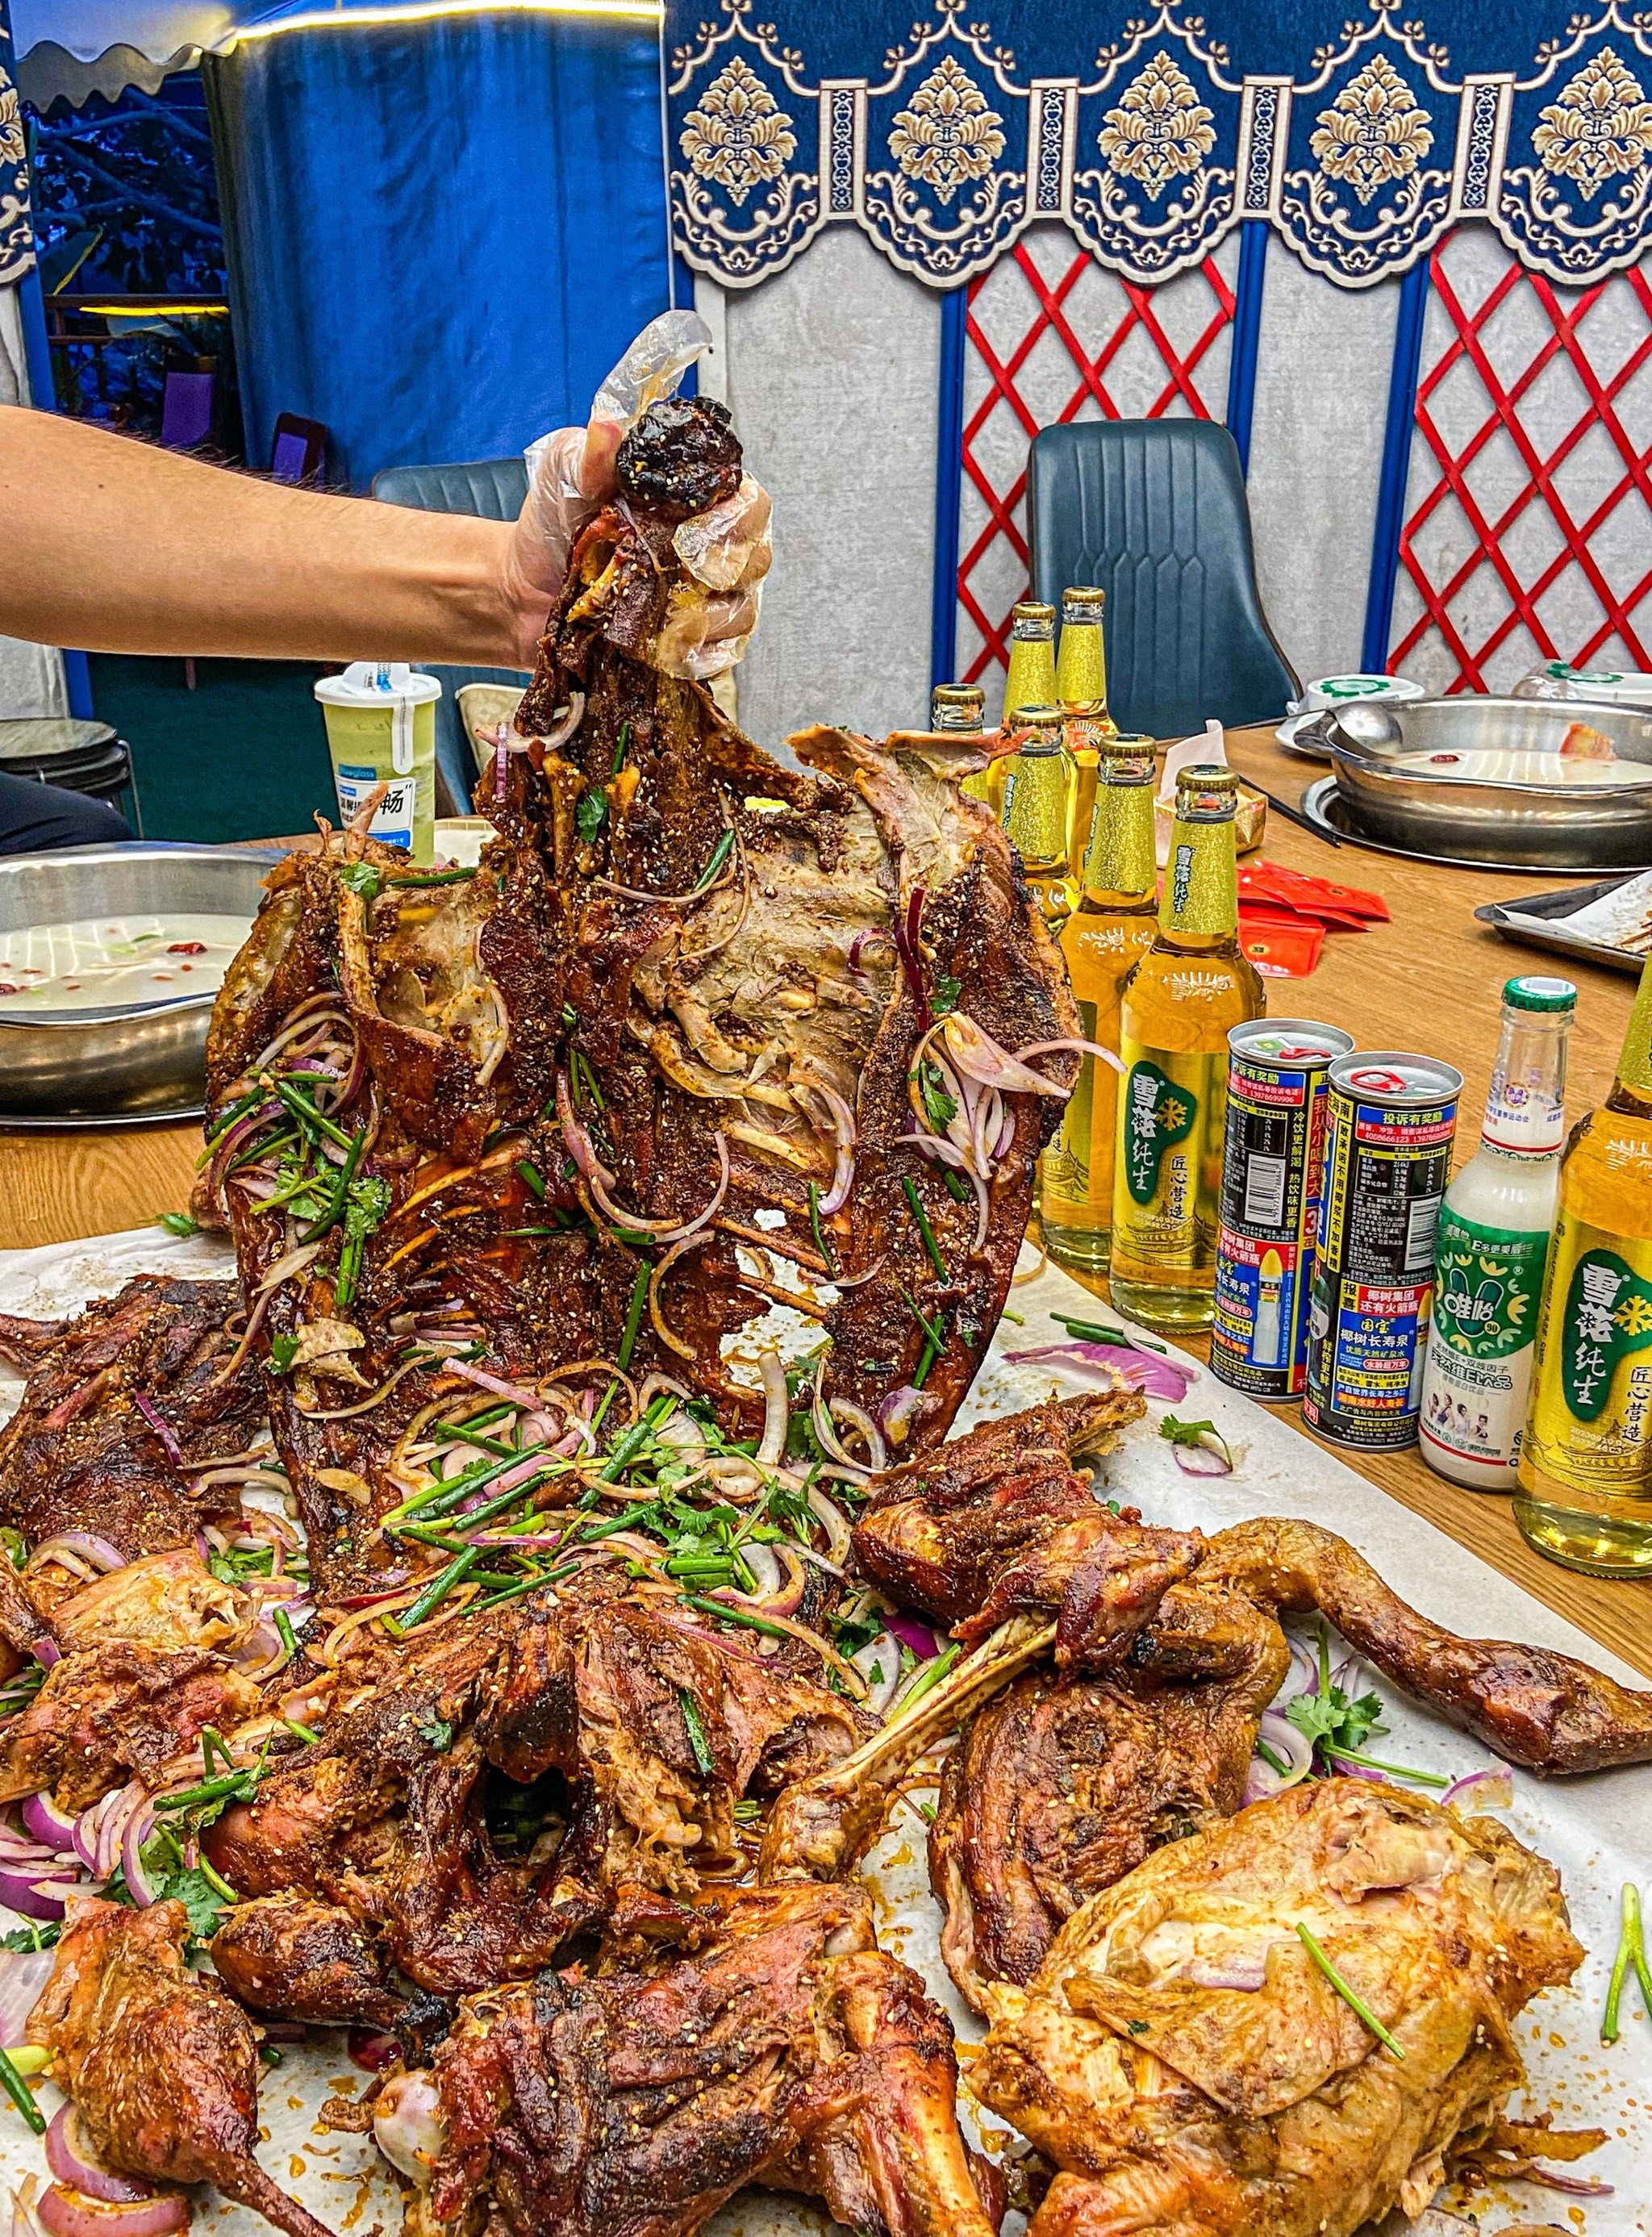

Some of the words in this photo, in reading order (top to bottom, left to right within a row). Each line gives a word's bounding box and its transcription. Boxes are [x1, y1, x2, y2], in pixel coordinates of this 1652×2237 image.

[1131, 1074, 1159, 1191] 雪花纯生
[1291, 1110, 1306, 1167] 冷饮更解渴
[1383, 1111, 1442, 1125] 投诉有奖励
[1170, 1155, 1188, 1221] 匠心营造
[1286, 1173, 1300, 1228] 热饮味更香
[1367, 1289, 1415, 1302] 椰树集团
[1444, 1292, 1494, 1321] 唯怡
[1341, 1328, 1408, 1347] 椰树长寿泉
[1487, 1323, 1498, 1333] 90
[1574, 1263, 1622, 1405] 雪花纯生
[1624, 1367, 1652, 1442] 匠心营造
